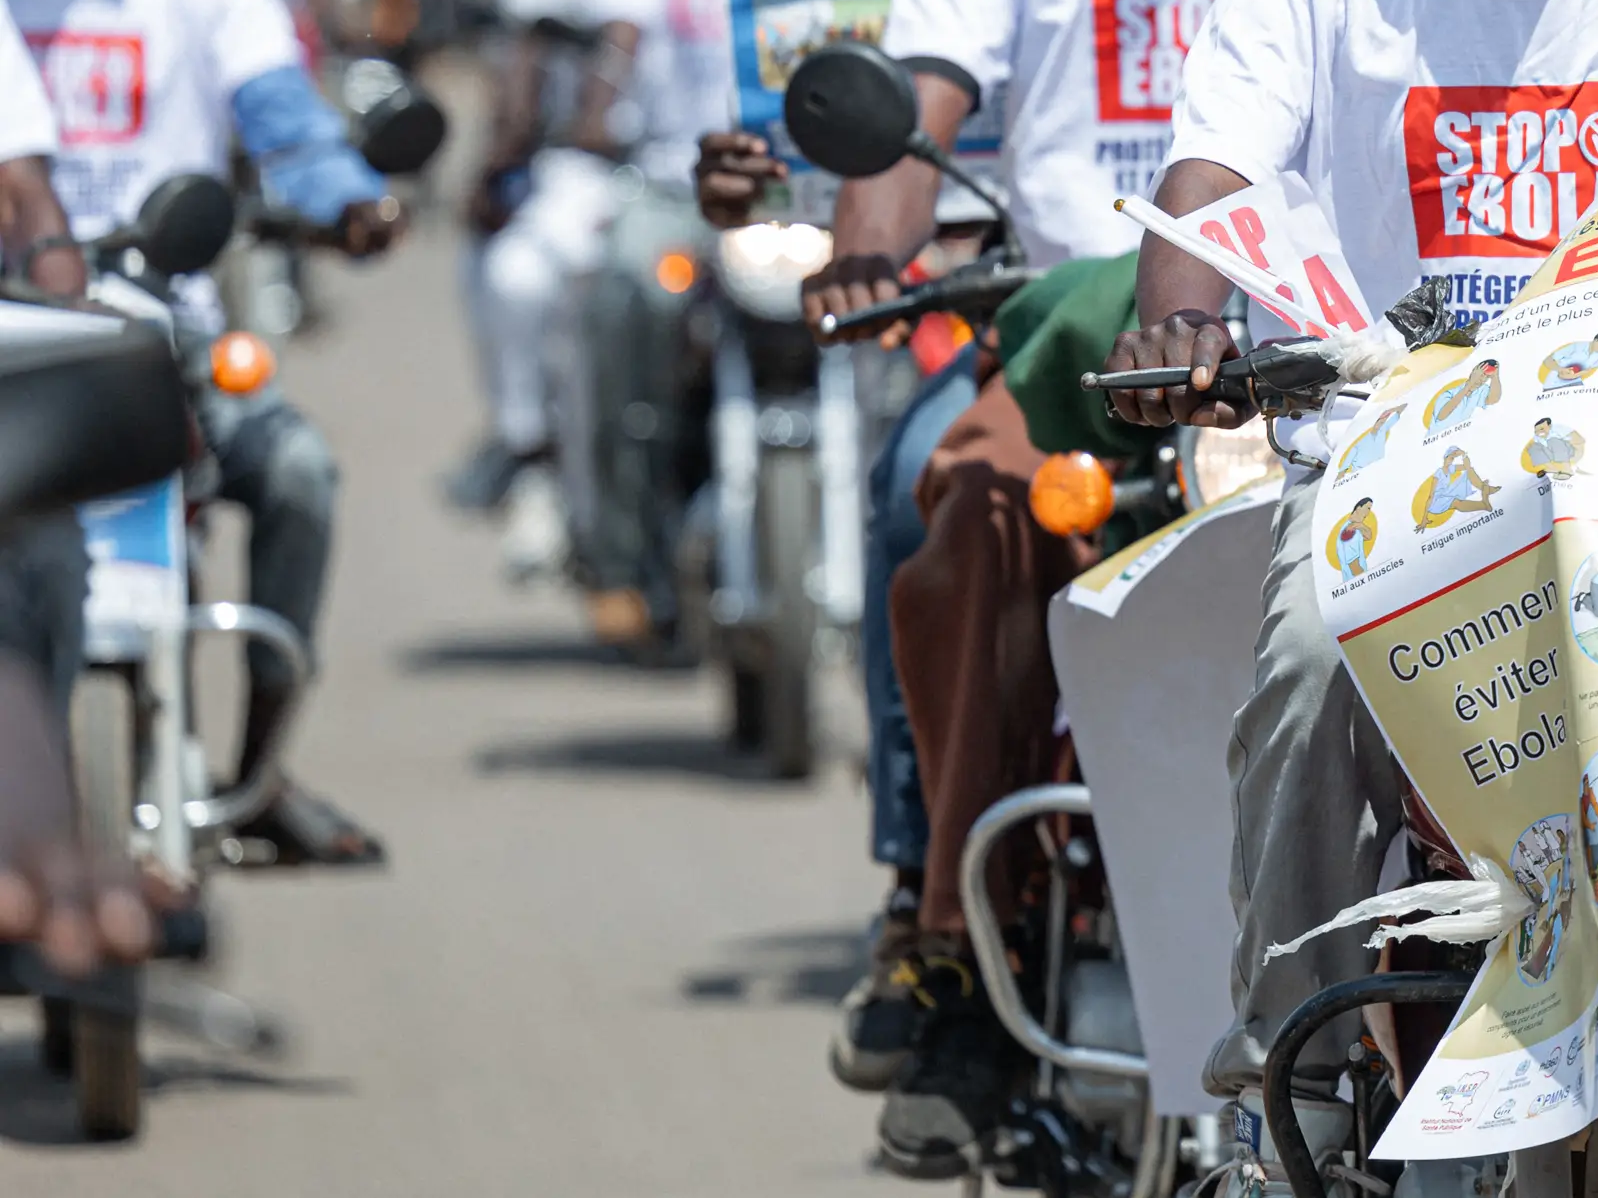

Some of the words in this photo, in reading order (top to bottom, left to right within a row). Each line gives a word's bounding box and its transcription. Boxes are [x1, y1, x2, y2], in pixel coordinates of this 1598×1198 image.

[1434, 109, 1577, 175] STOP
[1556, 294, 1577, 308] de
[1485, 321, 1531, 346] santé
[1537, 314, 1551, 329] le
[1556, 305, 1593, 326] plus
[1536, 390, 1554, 402] Mal
[1557, 389, 1570, 397] au
[1422, 434, 1439, 447] Mal
[1441, 428, 1452, 439] de
[1453, 419, 1472, 434] tête
[1421, 533, 1455, 555] Fatigue
[1455, 508, 1505, 539] importante
[1332, 585, 1348, 600] Mal
[1349, 577, 1366, 592] aux
[1367, 558, 1405, 583] muscles
[1455, 647, 1559, 722] éviter
[1462, 713, 1568, 787] Ebola
